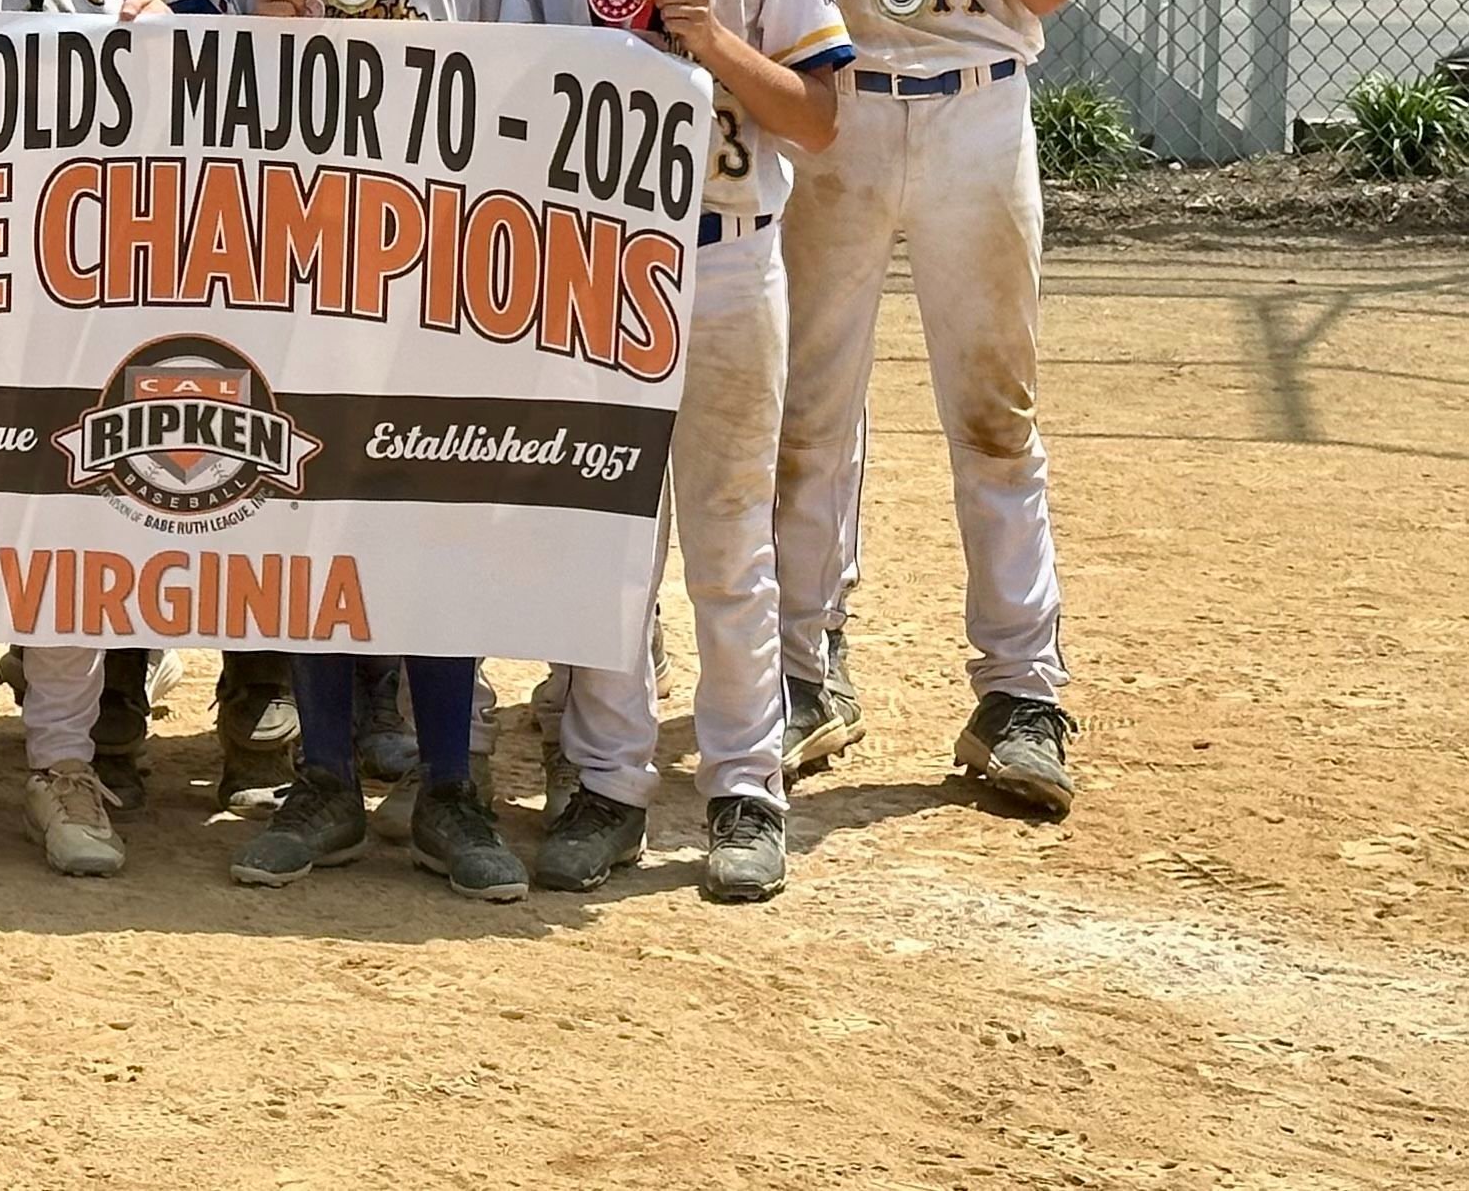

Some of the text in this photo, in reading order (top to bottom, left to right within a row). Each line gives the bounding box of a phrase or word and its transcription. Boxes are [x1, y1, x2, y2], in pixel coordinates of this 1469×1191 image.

[171, 29, 385, 161] MAJOR
[404, 45, 477, 172] 70
[547, 72, 695, 222] 2026
[33, 155, 685, 384] CHAMPIONS
[140, 378, 237, 395] CAL
[90, 403, 283, 468] RIPKEN
[365, 421, 642, 481] Established 1951
[124, 474, 247, 510] BASEBALL
[143, 514, 175, 534] BABE
[177, 521, 209, 535] RUTH
